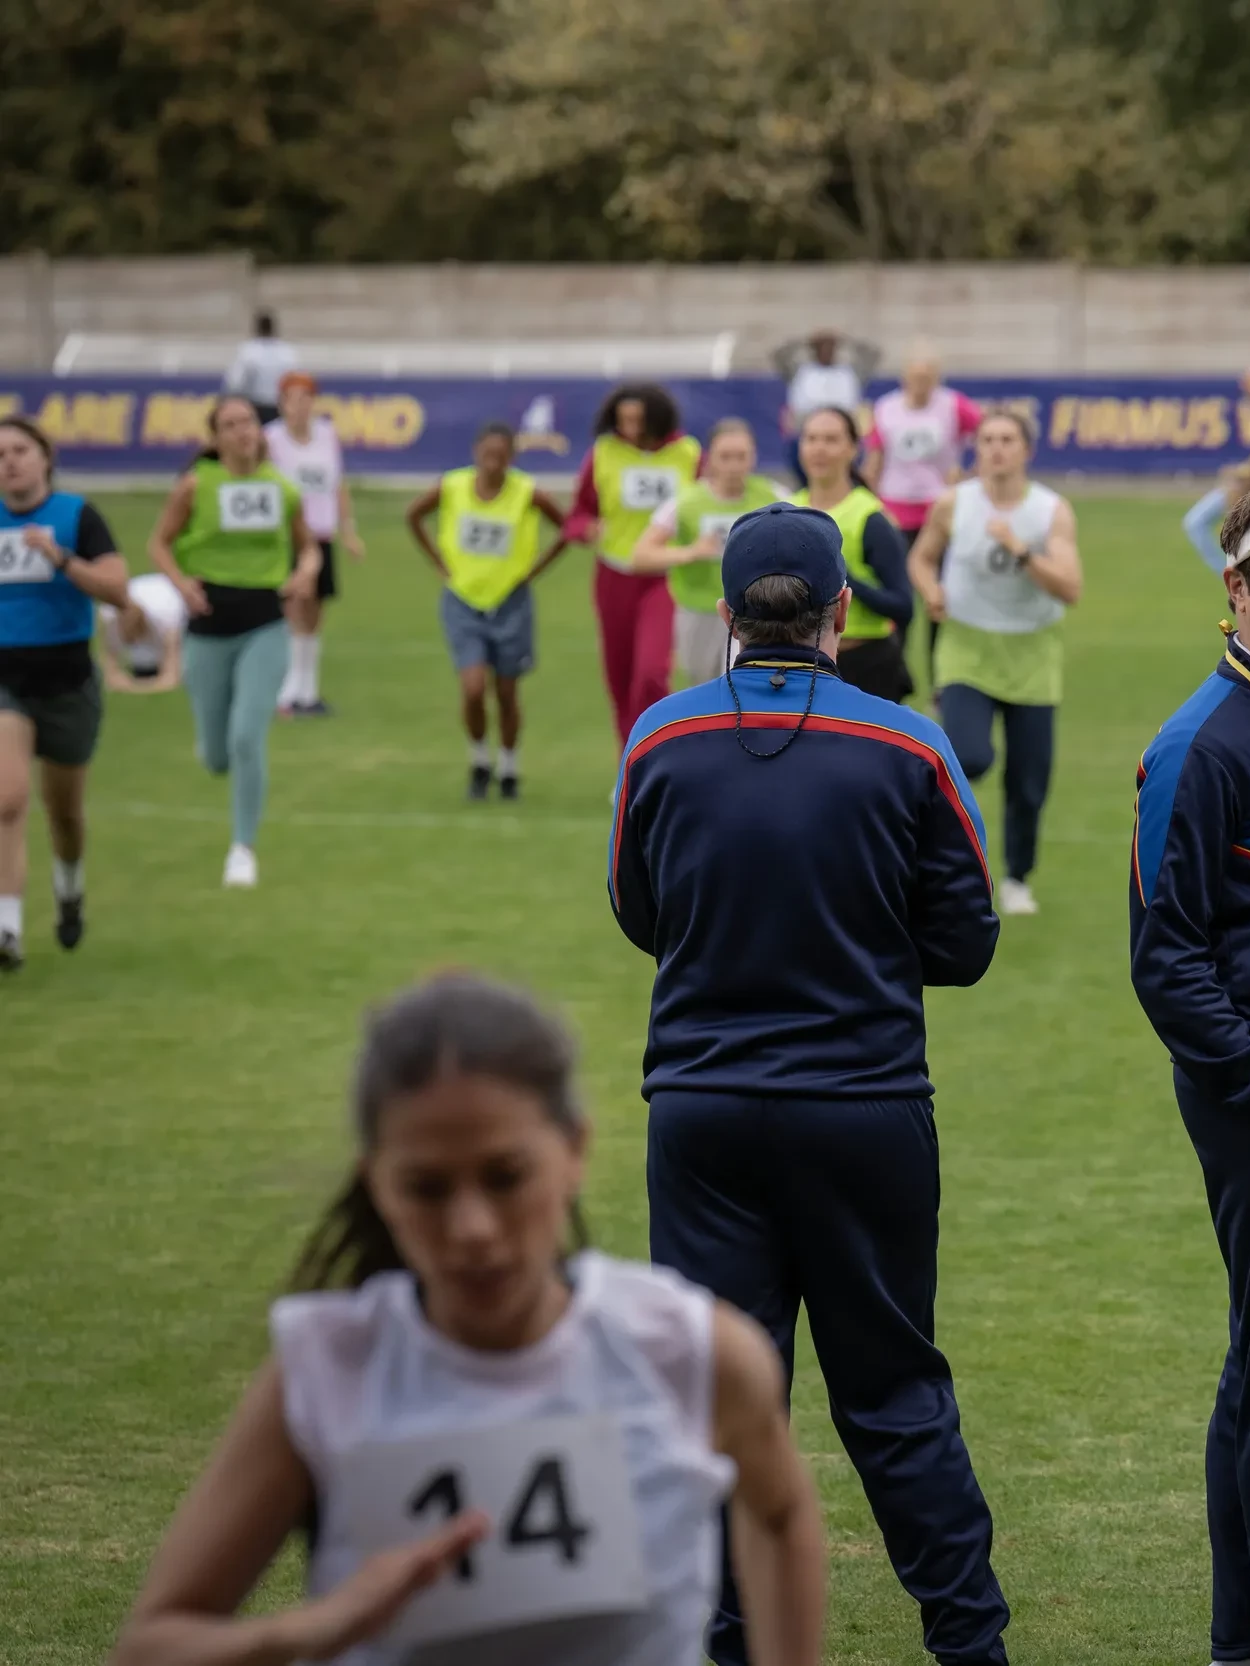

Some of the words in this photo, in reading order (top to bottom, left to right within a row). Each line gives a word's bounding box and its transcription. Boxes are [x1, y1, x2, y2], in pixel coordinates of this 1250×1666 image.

[1049, 396, 1229, 449] FIRMUS
[229, 488, 272, 520] 04
[408, 1454, 588, 1584] 14
